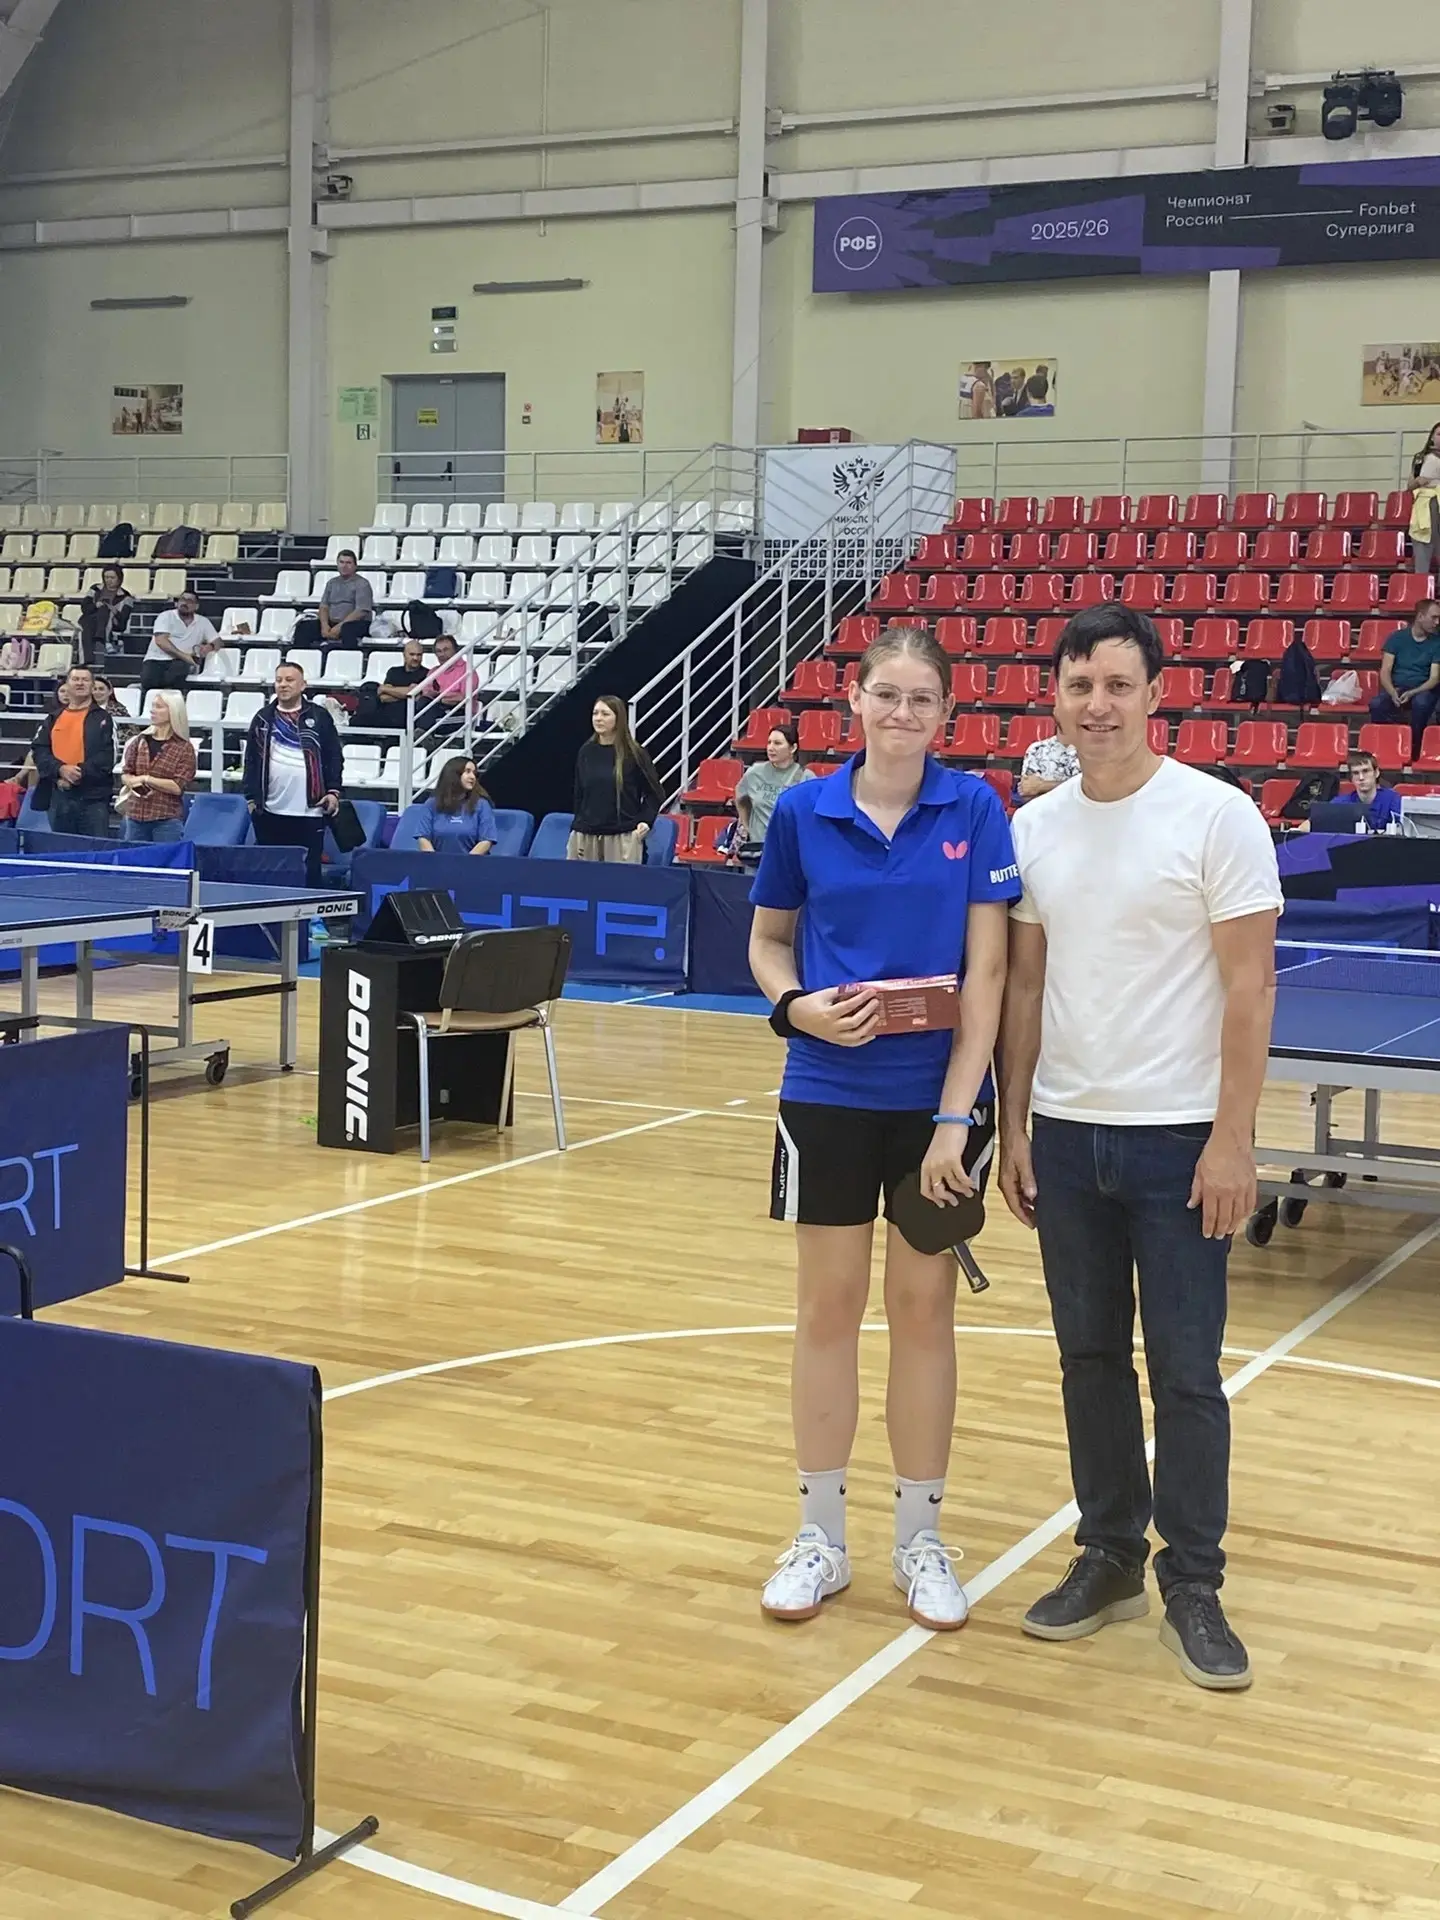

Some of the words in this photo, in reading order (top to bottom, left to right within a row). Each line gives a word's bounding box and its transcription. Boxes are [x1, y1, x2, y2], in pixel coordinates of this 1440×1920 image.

[1167, 193, 1252, 209] Чемпионат
[1359, 201, 1416, 217] Fonbet
[1030, 218, 1110, 240] 2025/26
[1165, 214, 1224, 228] России
[1326, 222, 1416, 240] Суперлига
[840, 235, 877, 252] РФБ
[316, 902, 353, 914] DONIC
[192, 922, 210, 967] 4
